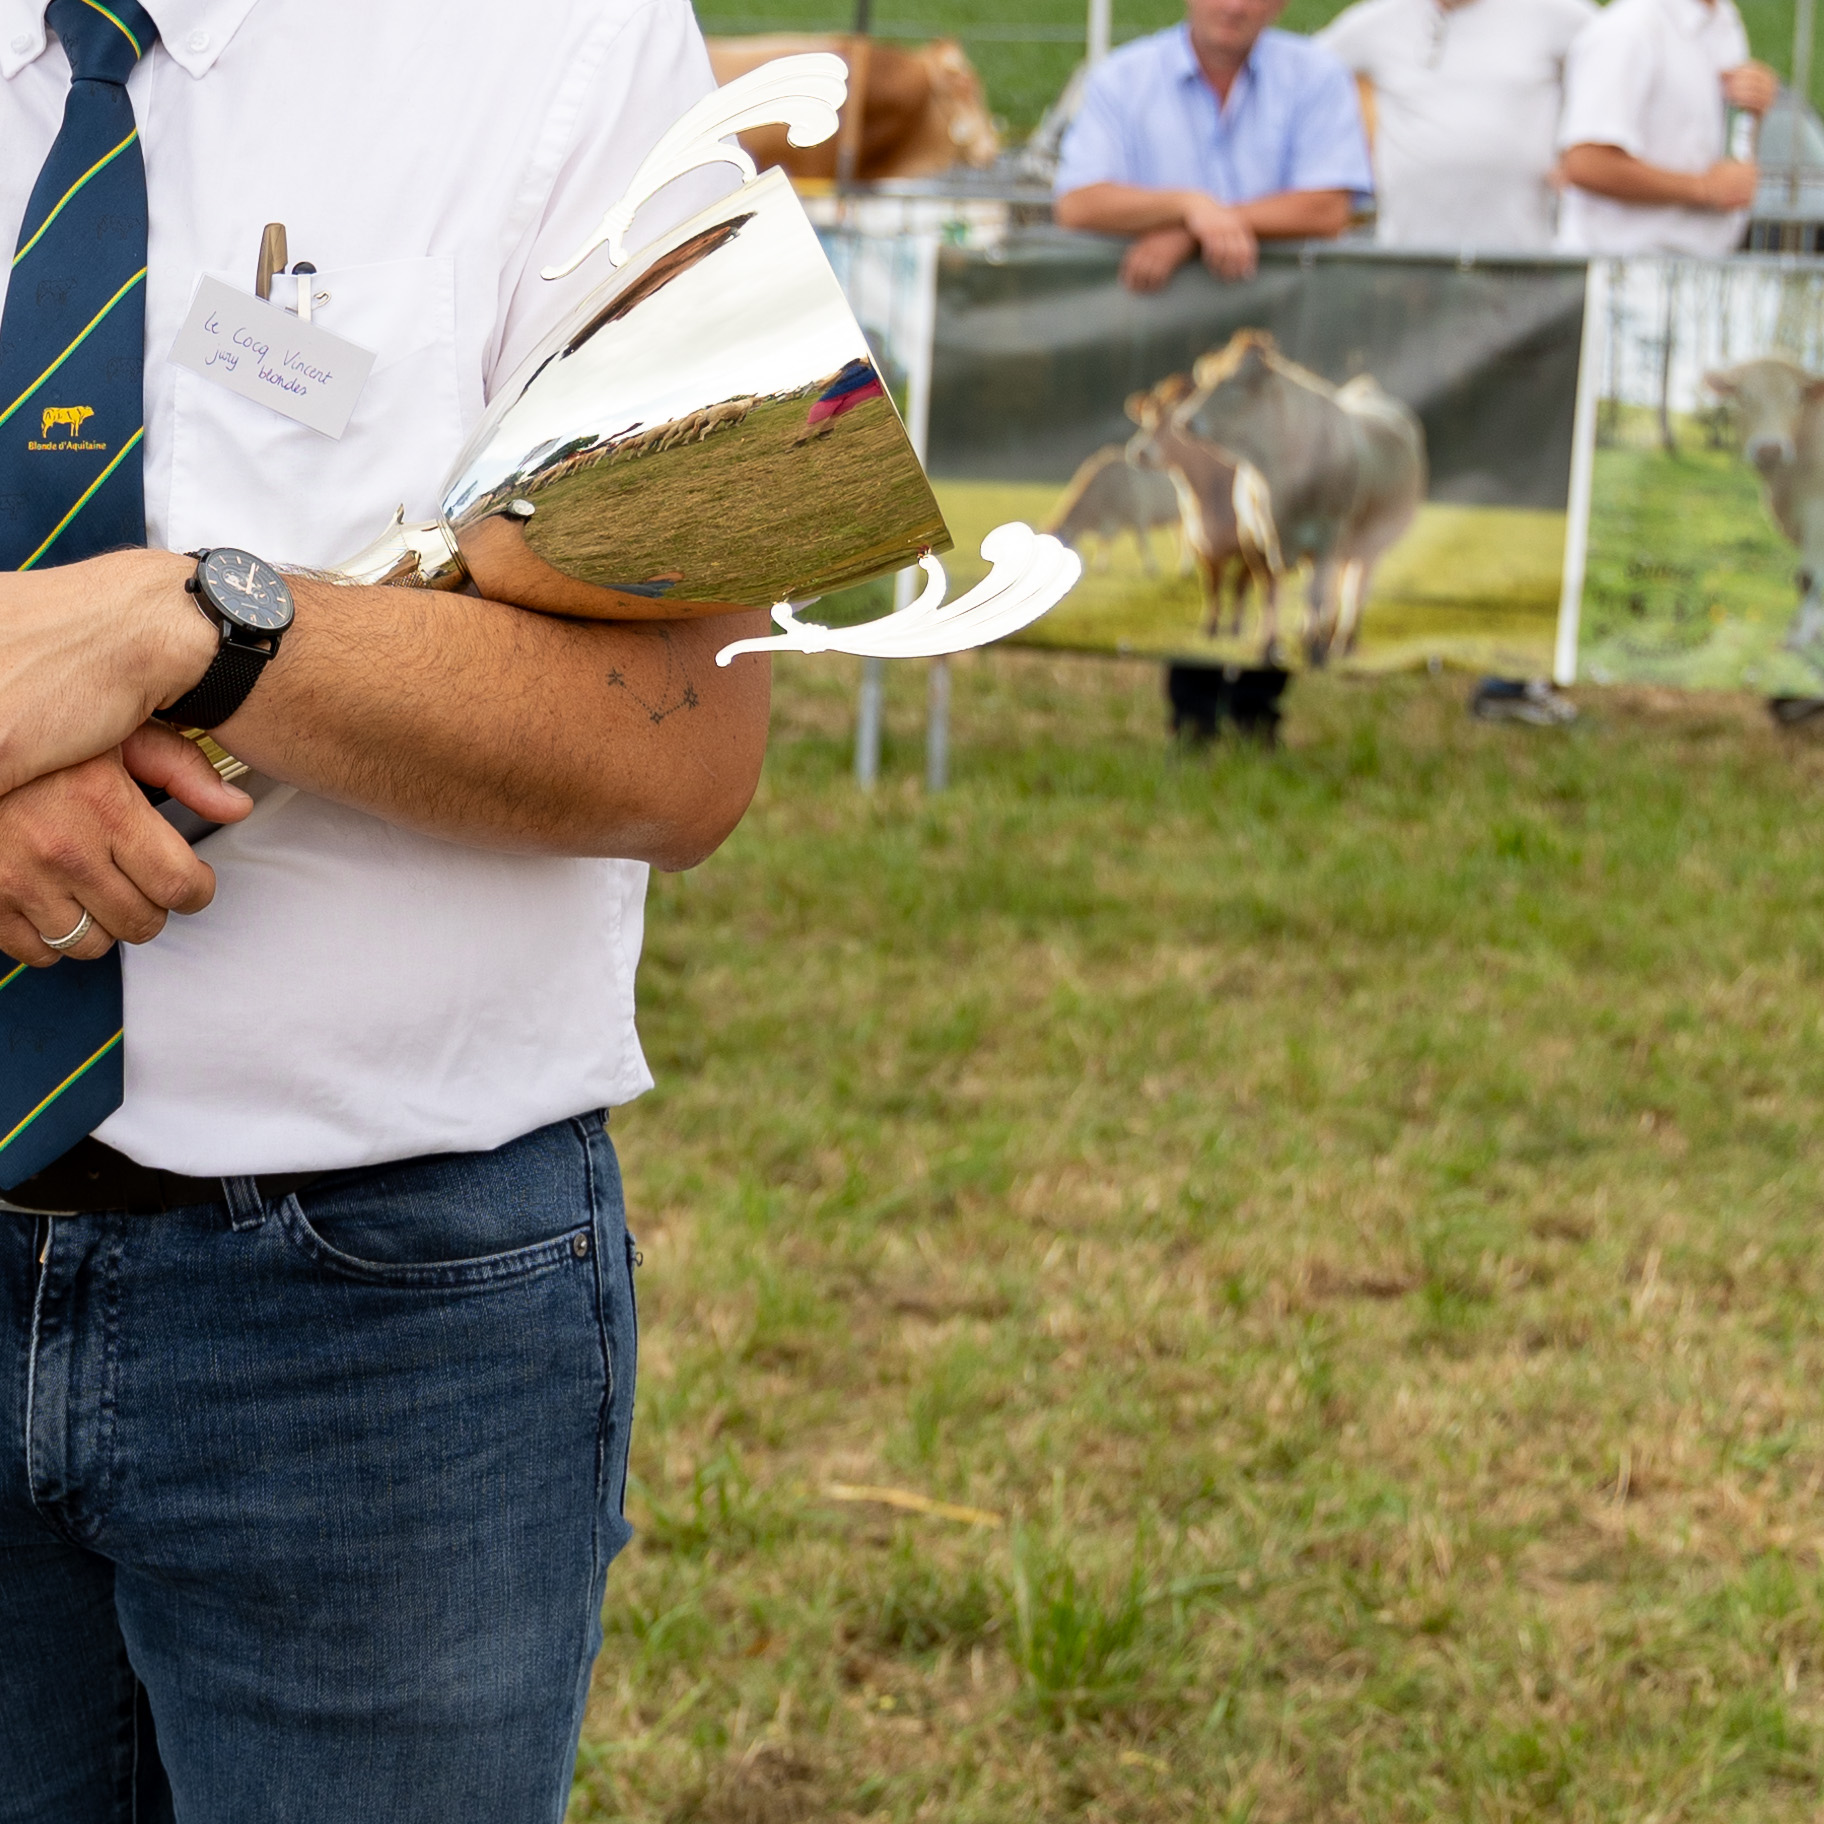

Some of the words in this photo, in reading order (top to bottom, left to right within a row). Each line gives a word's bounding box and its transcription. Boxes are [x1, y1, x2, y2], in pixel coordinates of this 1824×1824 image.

[204, 311, 220, 334] Le
[233, 327, 269, 364] Cocq
[283, 350, 333, 384] Vincent
[204, 344, 239, 371] jury
[258, 365, 307, 396] blondes
[28, 441, 57, 451] Blonde
[58, 440, 107, 453] d'Aquitaine
